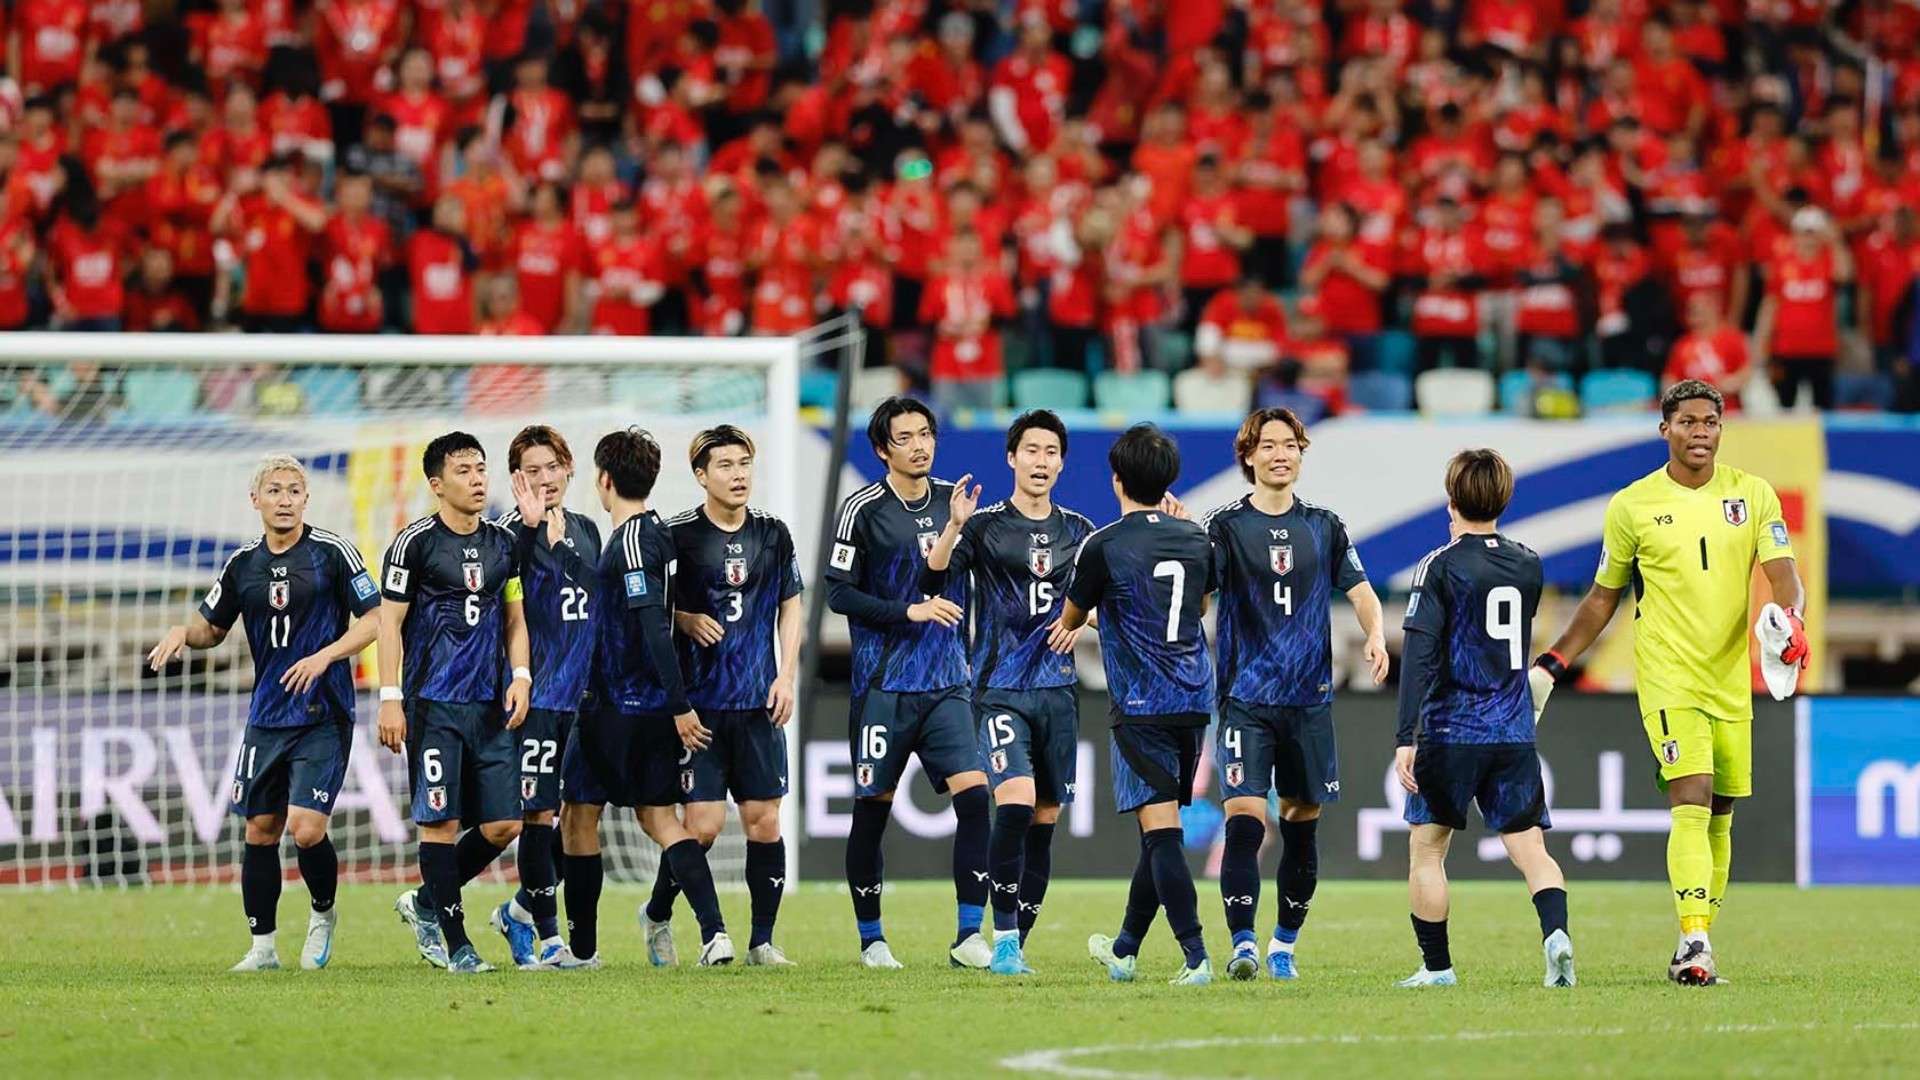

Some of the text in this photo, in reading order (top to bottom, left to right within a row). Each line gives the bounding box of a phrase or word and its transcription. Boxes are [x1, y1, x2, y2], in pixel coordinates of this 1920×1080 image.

[1269, 528, 1289, 540] Y-3
[1654, 514, 1673, 527] Y-3
[1700, 535, 1709, 571] 1
[464, 594, 480, 626] 6
[560, 586, 589, 621] 22
[726, 591, 743, 622] 3
[1028, 581, 1054, 616] 15
[1153, 559, 1186, 643] 7
[1273, 580, 1292, 616] 4
[270, 614, 291, 648] 11
[1486, 585, 1523, 670] 9
[987, 714, 1016, 749] 15
[1660, 708, 1669, 737] 1
[521, 738, 558, 774] 22
[862, 724, 888, 760] 16
[1225, 726, 1242, 758] 4
[237, 743, 257, 779] 11
[423, 748, 443, 784] 6
[526, 885, 555, 898] Y-3
[856, 883, 881, 897] Y-3
[991, 879, 1019, 894] Y-3
[1224, 895, 1253, 907] Y-3
[1676, 887, 1707, 901] Y-3
